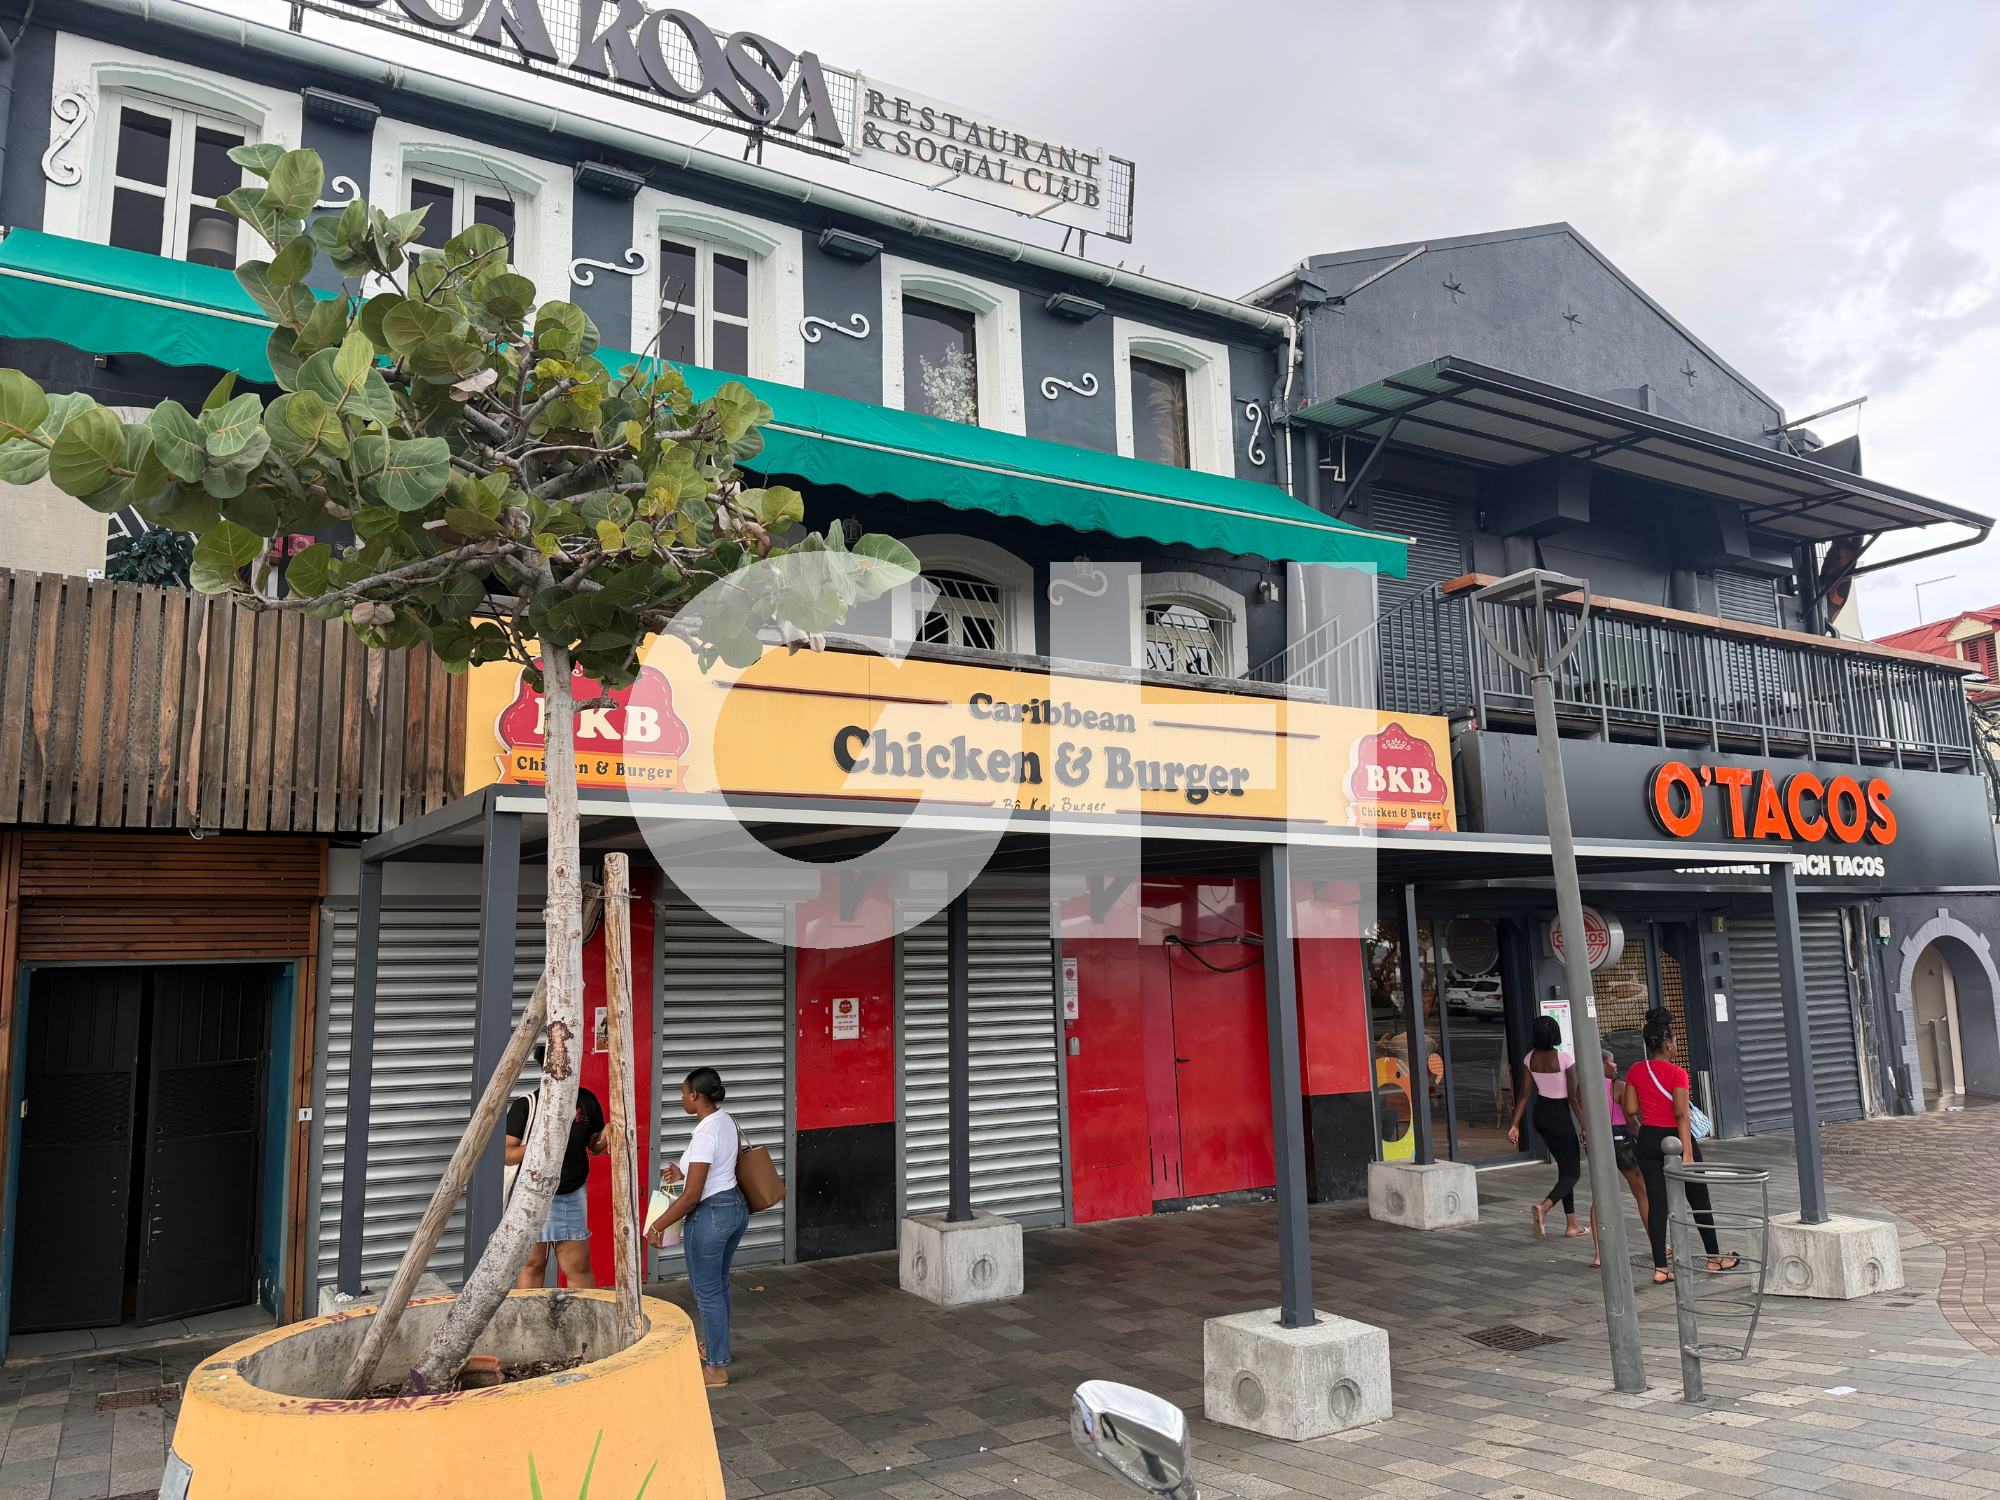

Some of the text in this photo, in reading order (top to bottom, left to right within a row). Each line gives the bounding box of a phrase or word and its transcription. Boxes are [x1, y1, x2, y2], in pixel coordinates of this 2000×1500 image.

[867, 88, 1100, 179] RESTAURANT
[863, 121, 1100, 208] & SOCIAL CLUB
[533, 696, 661, 742] KB
[968, 692, 1136, 733] Caribbean
[516, 755, 673, 780] Chin & Burger
[832, 724, 1249, 805] Chicken & Burger
[1365, 764, 1433, 794] BKB
[1061, 796, 1106, 814] Burger
[1361, 806, 1441, 821] Chicken & Burger
[1652, 761, 1897, 845] O'TACOS
[1763, 855, 1831, 876] NCH
[1832, 855, 1885, 877] TACOS
